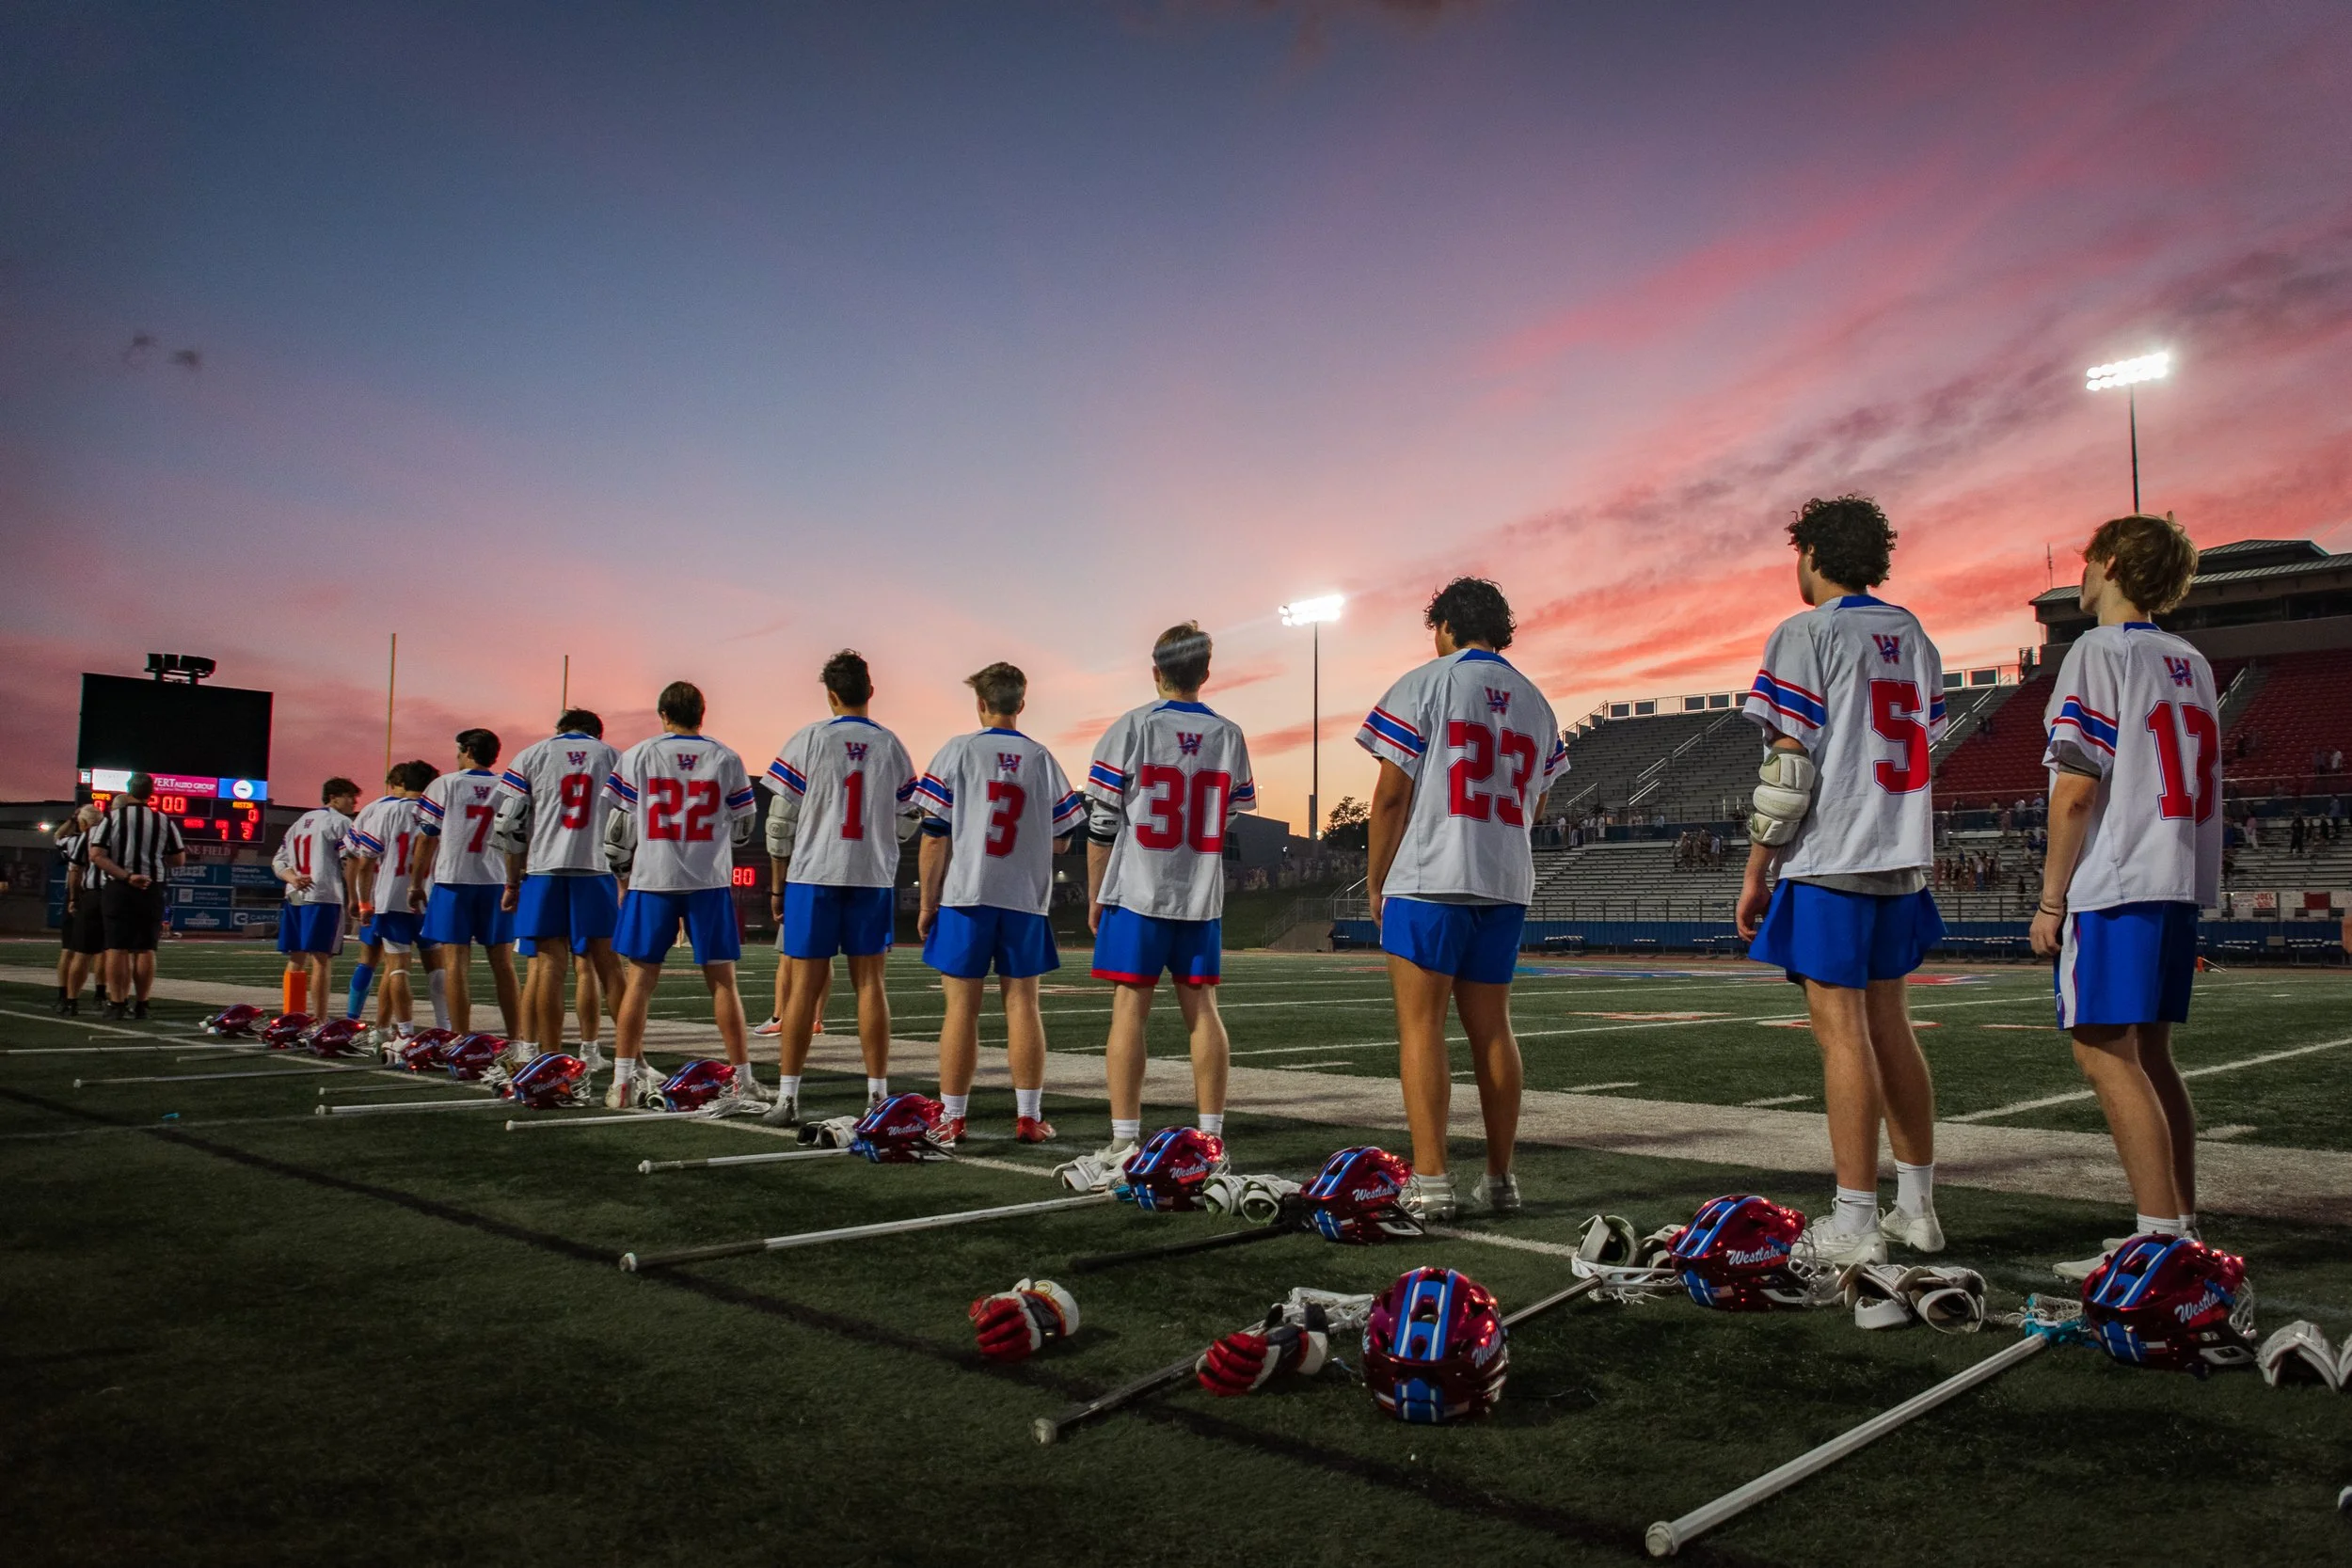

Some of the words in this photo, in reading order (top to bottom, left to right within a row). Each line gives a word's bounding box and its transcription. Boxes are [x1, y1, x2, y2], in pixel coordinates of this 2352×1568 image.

[1867, 678, 1931, 795] 5
[2144, 700, 2217, 827] 13
[561, 773, 593, 830] 9
[1447, 720, 1538, 828] 23
[248, 809, 258, 821] 0
[466, 805, 494, 853] 7
[647, 776, 721, 842] 22
[840, 770, 865, 841] 1
[986, 780, 1026, 858] 3
[1136, 763, 1232, 854] 30
[202, 846, 230, 856] FIELD
[294, 834, 311, 875] 11
[732, 866, 755, 886] 80
[2174, 1288, 2223, 1323] Westla
